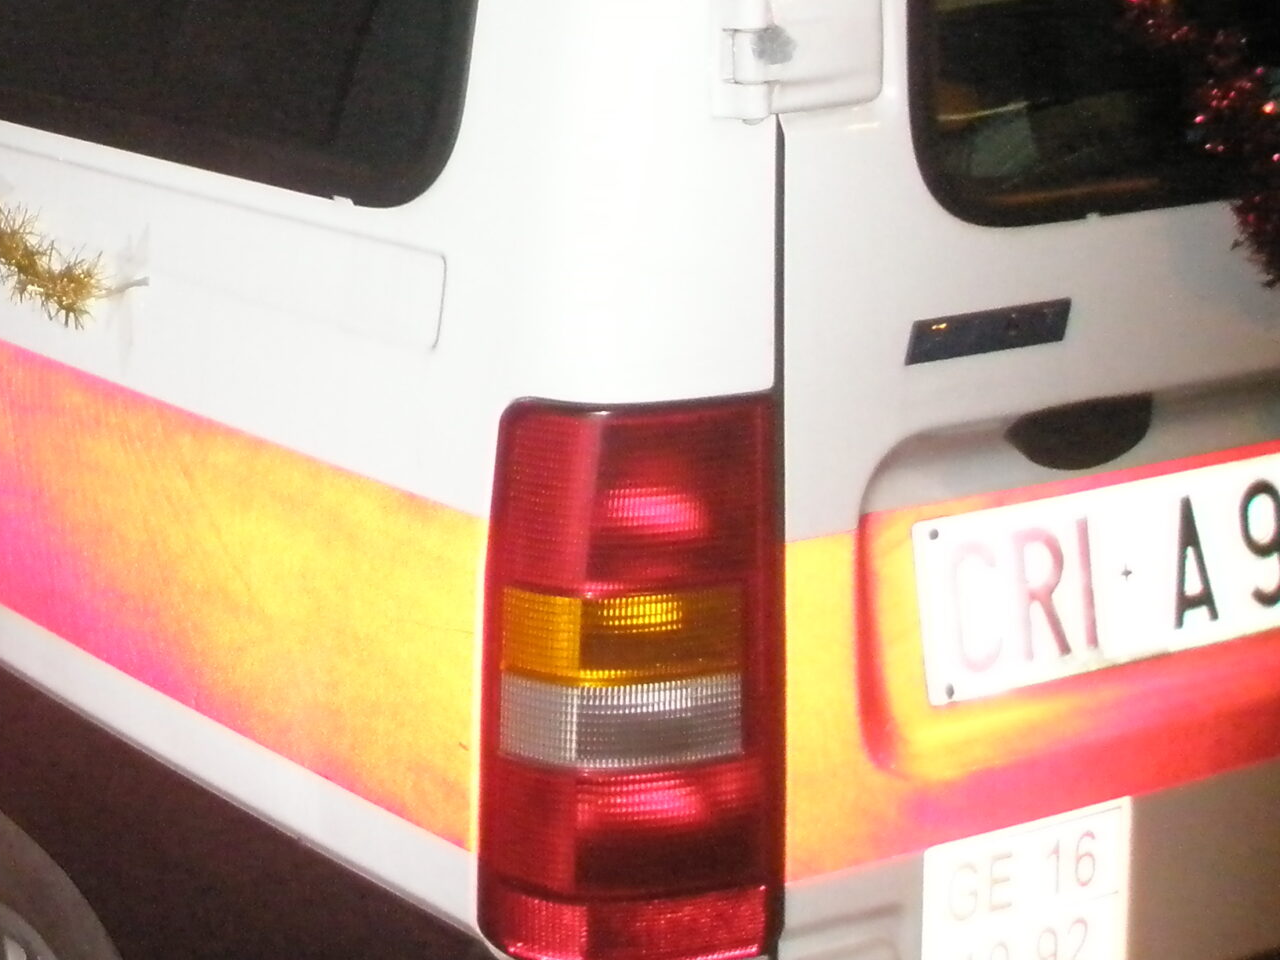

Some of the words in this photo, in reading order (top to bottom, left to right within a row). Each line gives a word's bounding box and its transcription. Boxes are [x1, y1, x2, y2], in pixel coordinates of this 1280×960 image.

[952, 516, 1099, 673] CRI
[948, 850, 1014, 922] GE
[1045, 828, 1097, 896] 16
